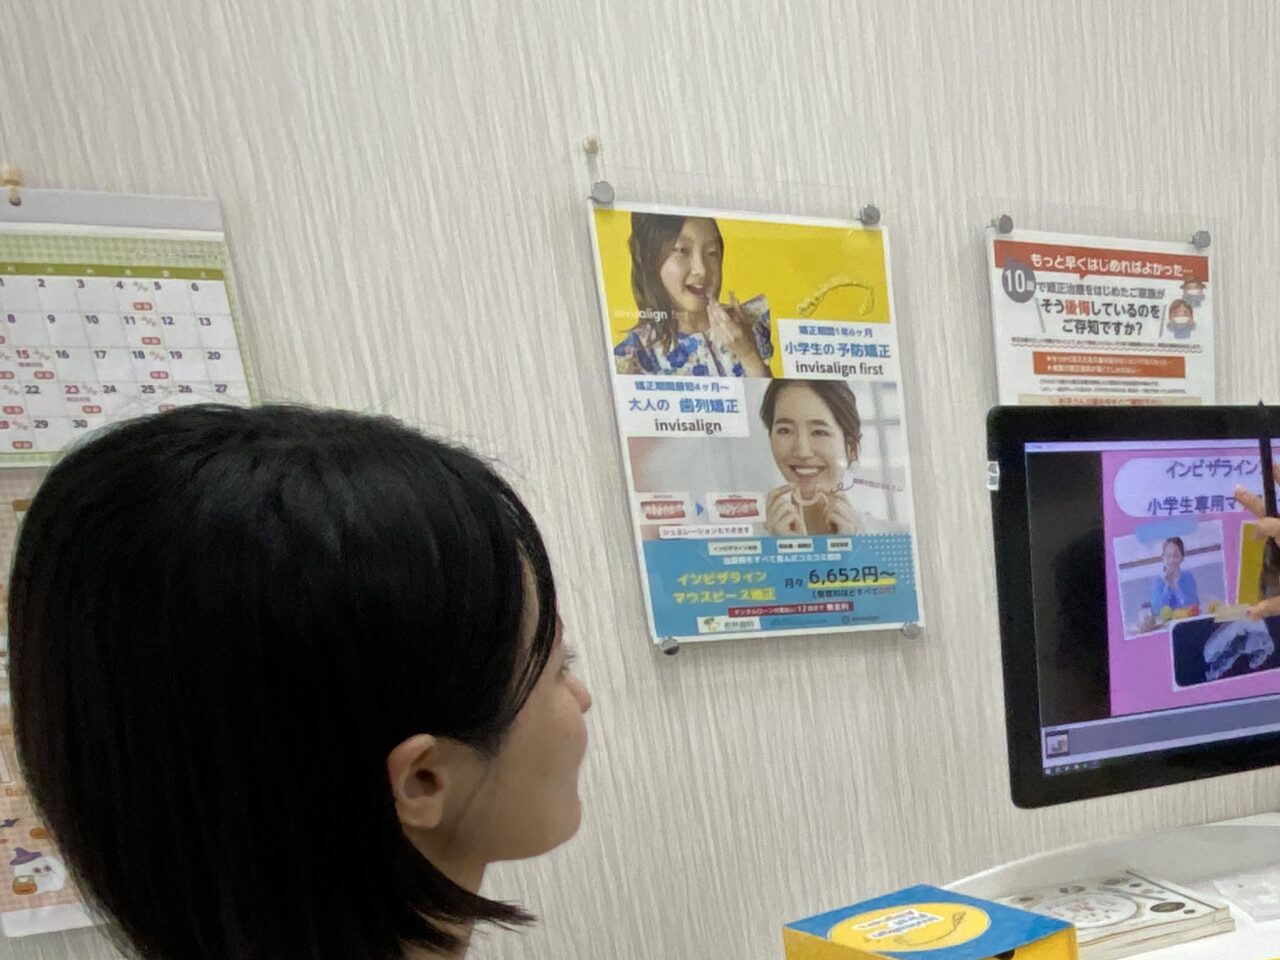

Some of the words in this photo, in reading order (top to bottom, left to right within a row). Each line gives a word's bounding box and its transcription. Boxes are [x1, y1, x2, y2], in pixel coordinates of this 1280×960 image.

[37, 278, 46, 288] 2
[76, 278, 86, 289] 3
[116, 280, 124, 289] 4
[154, 281, 162, 290] 5
[191, 282, 199, 292] 6
[7, 313, 16, 324] 8
[47, 314, 56, 324] 9
[85, 314, 99, 324] 10
[123, 315, 136, 325] 11
[161, 316, 175, 325] 12
[198, 317, 212, 326] 13
[16, 349, 30, 359] 15
[55, 350, 70, 359] 16
[94, 350, 106, 359] 17
[132, 350, 146, 359] 18
[169, 350, 182, 360] 19
[207, 351, 221, 360] 20
[796, 360, 857, 377] invisalign
[860, 362, 884, 375] first
[24, 385, 41, 394] 22
[64, 385, 80, 394] 23
[102, 384, 117, 394] 24
[141, 384, 155, 394] 25
[178, 384, 192, 394] 26
[214, 384, 228, 393] 27
[33, 419, 49, 429] 29
[73, 419, 88, 428] 30
[655, 418, 722, 435] invisalign
